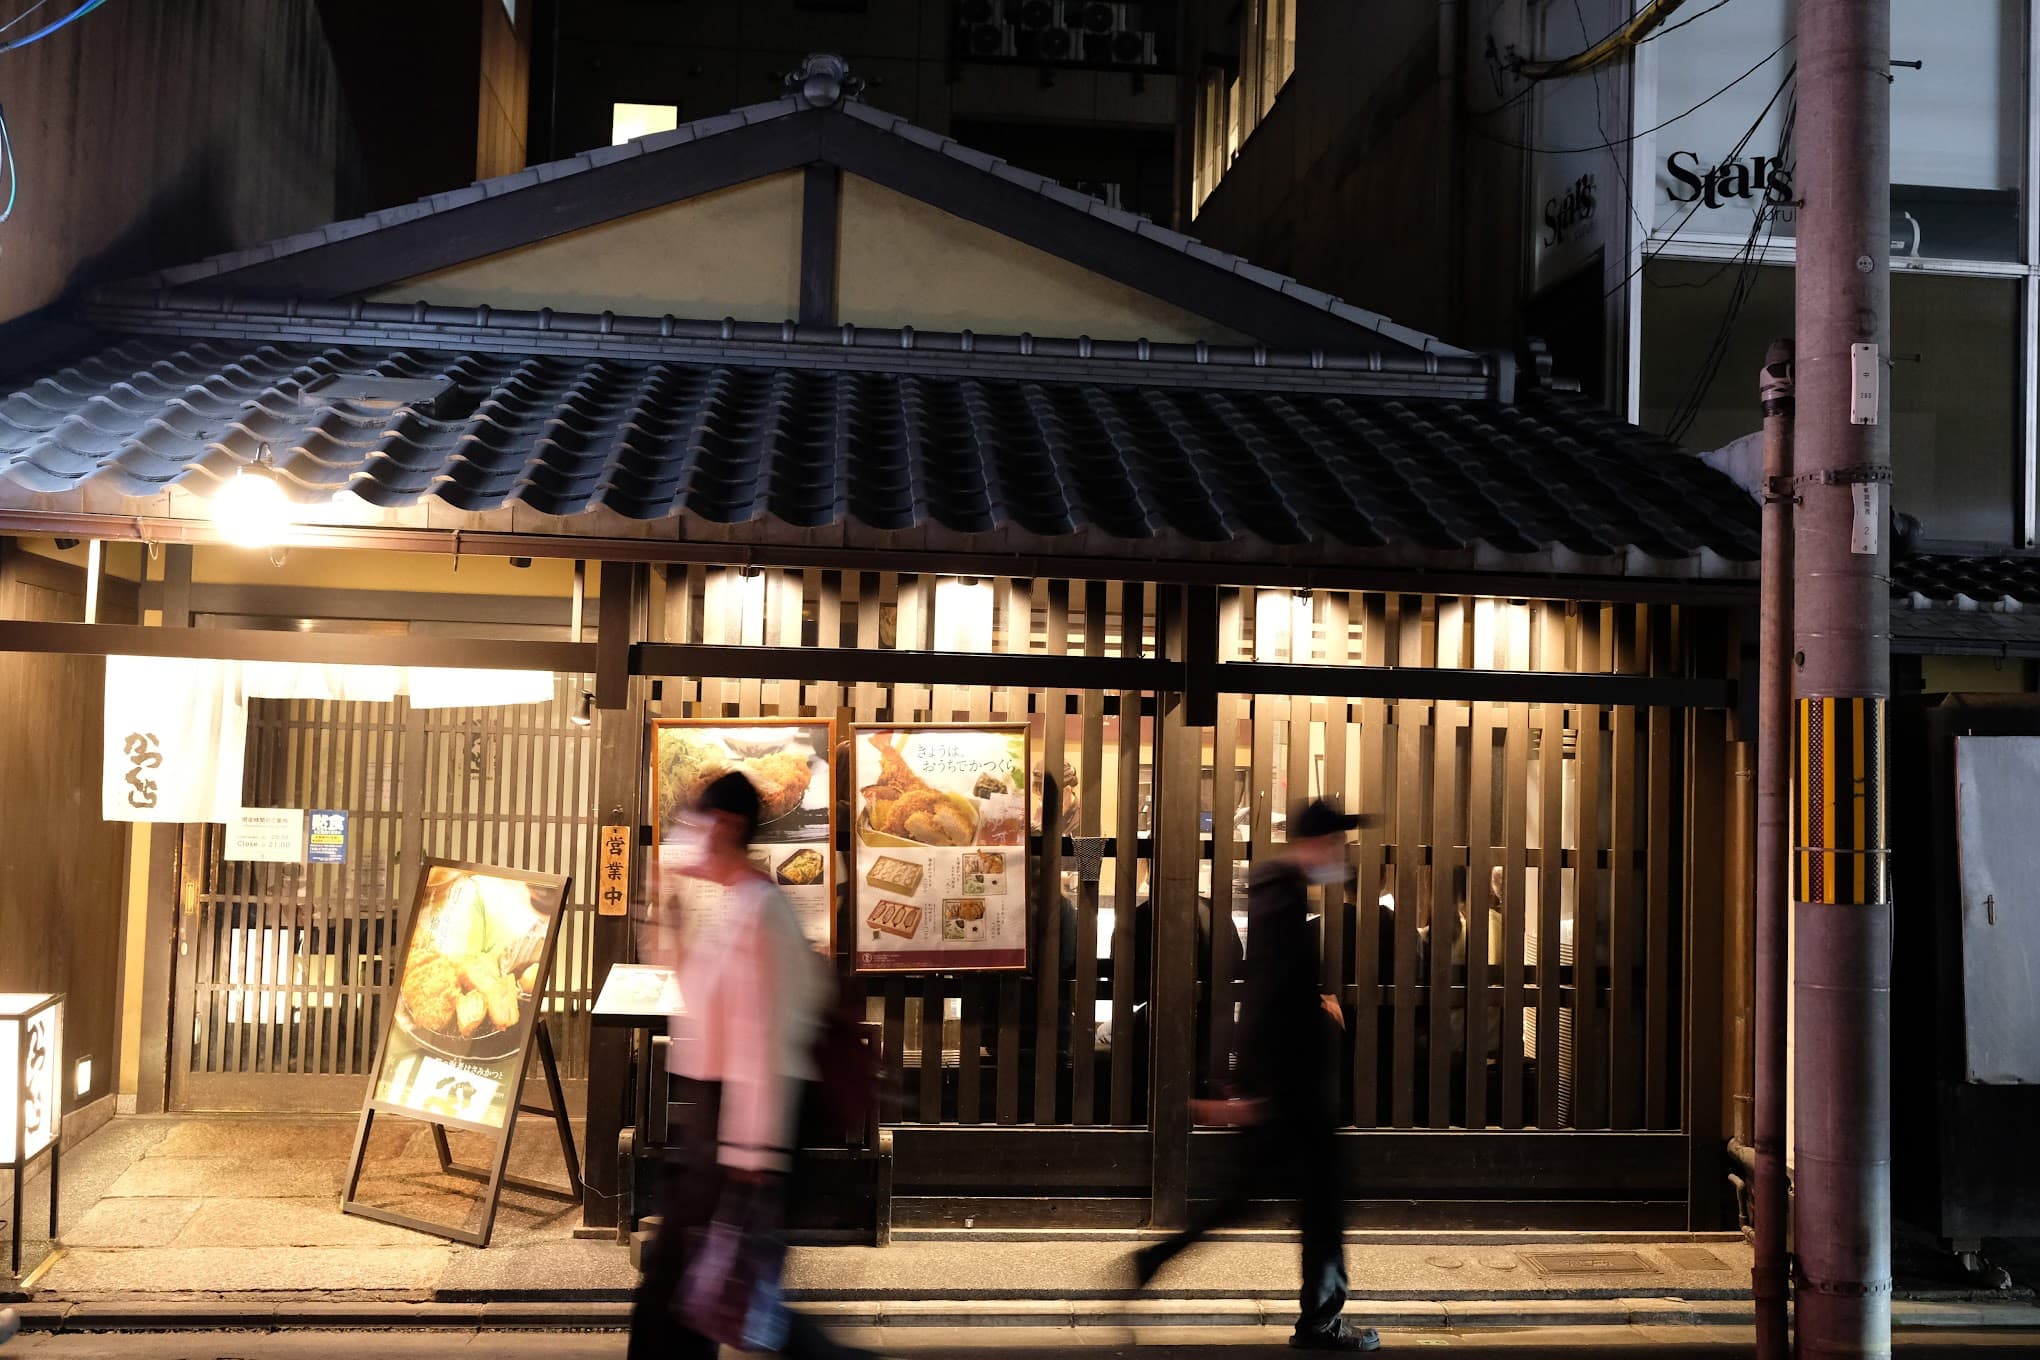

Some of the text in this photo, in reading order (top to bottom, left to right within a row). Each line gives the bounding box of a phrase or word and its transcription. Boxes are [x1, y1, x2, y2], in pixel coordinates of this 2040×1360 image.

[1666, 151, 1793, 209] Stars
[923, 759, 1016, 773] おうちでかつくら
[237, 840, 259, 848] Close
[604, 836, 625, 906] 営業中
